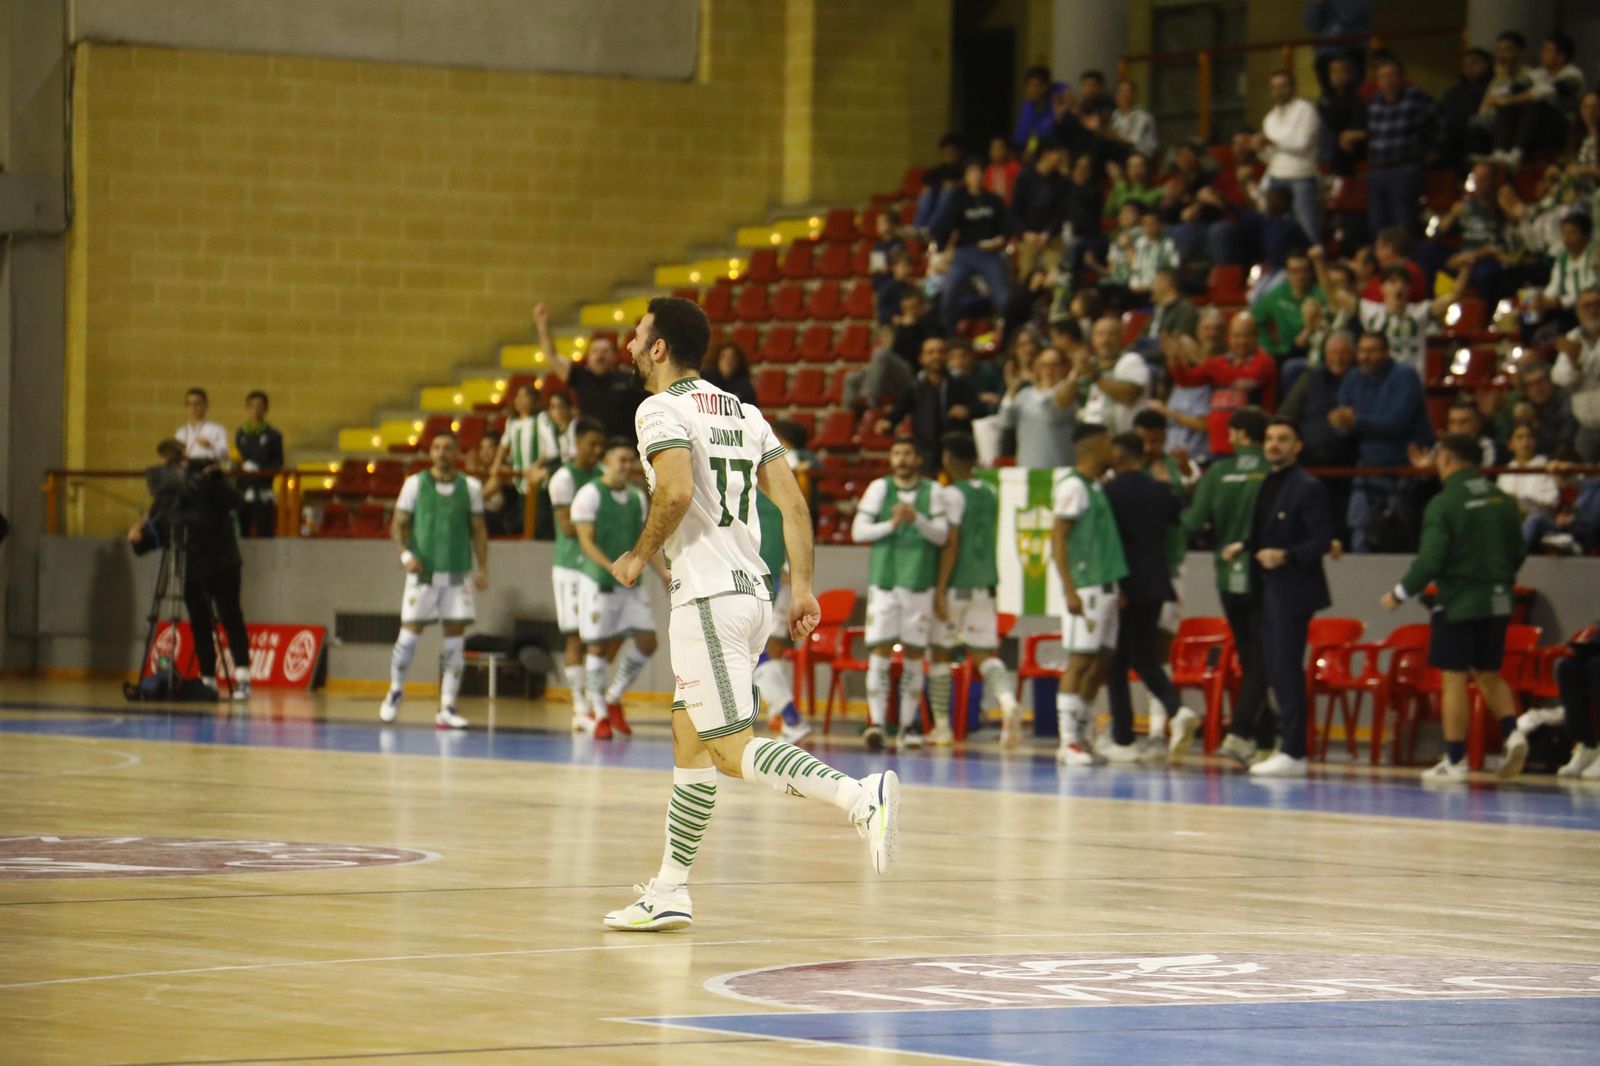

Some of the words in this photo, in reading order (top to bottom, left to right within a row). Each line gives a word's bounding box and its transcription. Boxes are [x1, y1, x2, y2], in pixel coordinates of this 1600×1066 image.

[710, 426, 743, 447] JUANAN
[709, 457, 753, 527] 17
[813, 975, 1600, 1006] IMDEC
